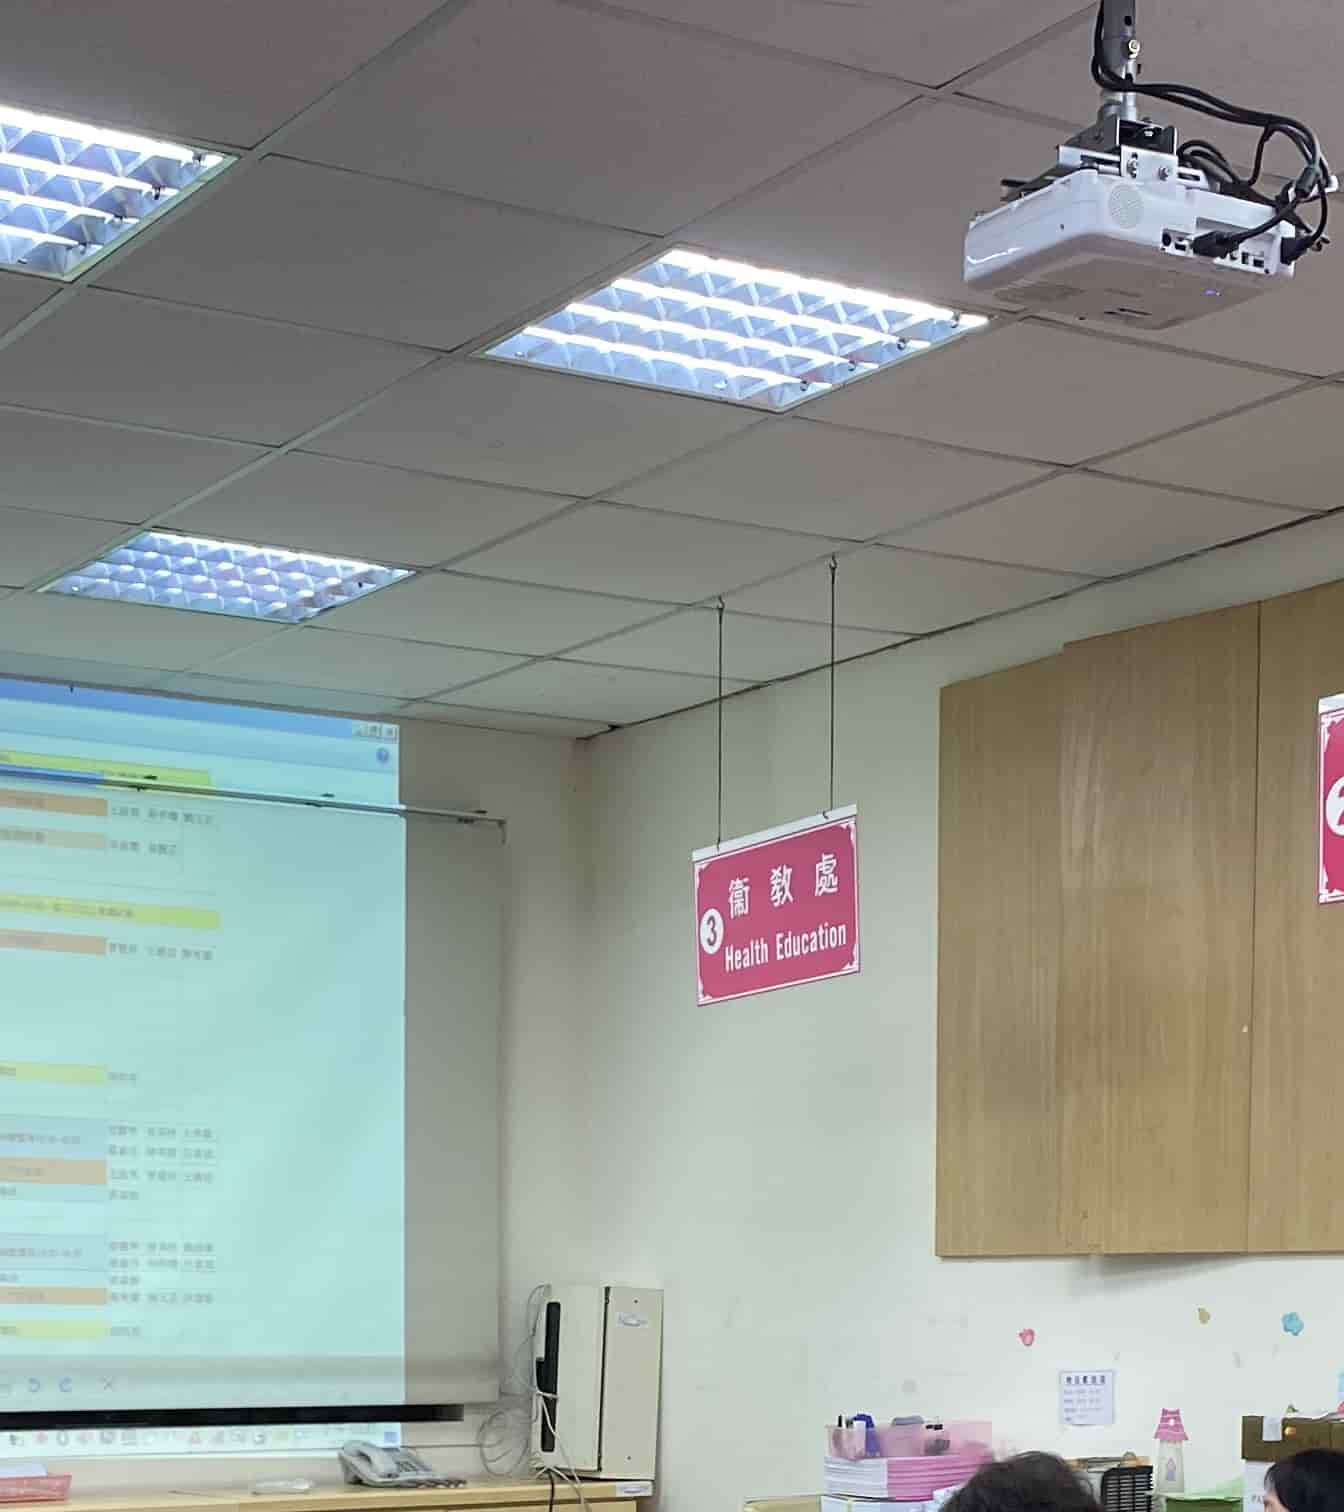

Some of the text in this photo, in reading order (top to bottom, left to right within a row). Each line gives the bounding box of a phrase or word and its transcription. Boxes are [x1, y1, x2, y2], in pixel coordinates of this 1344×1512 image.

[728, 853, 839, 919] 衛教處
[706, 915, 717, 947] 3
[725, 922, 847, 973] Health Education
